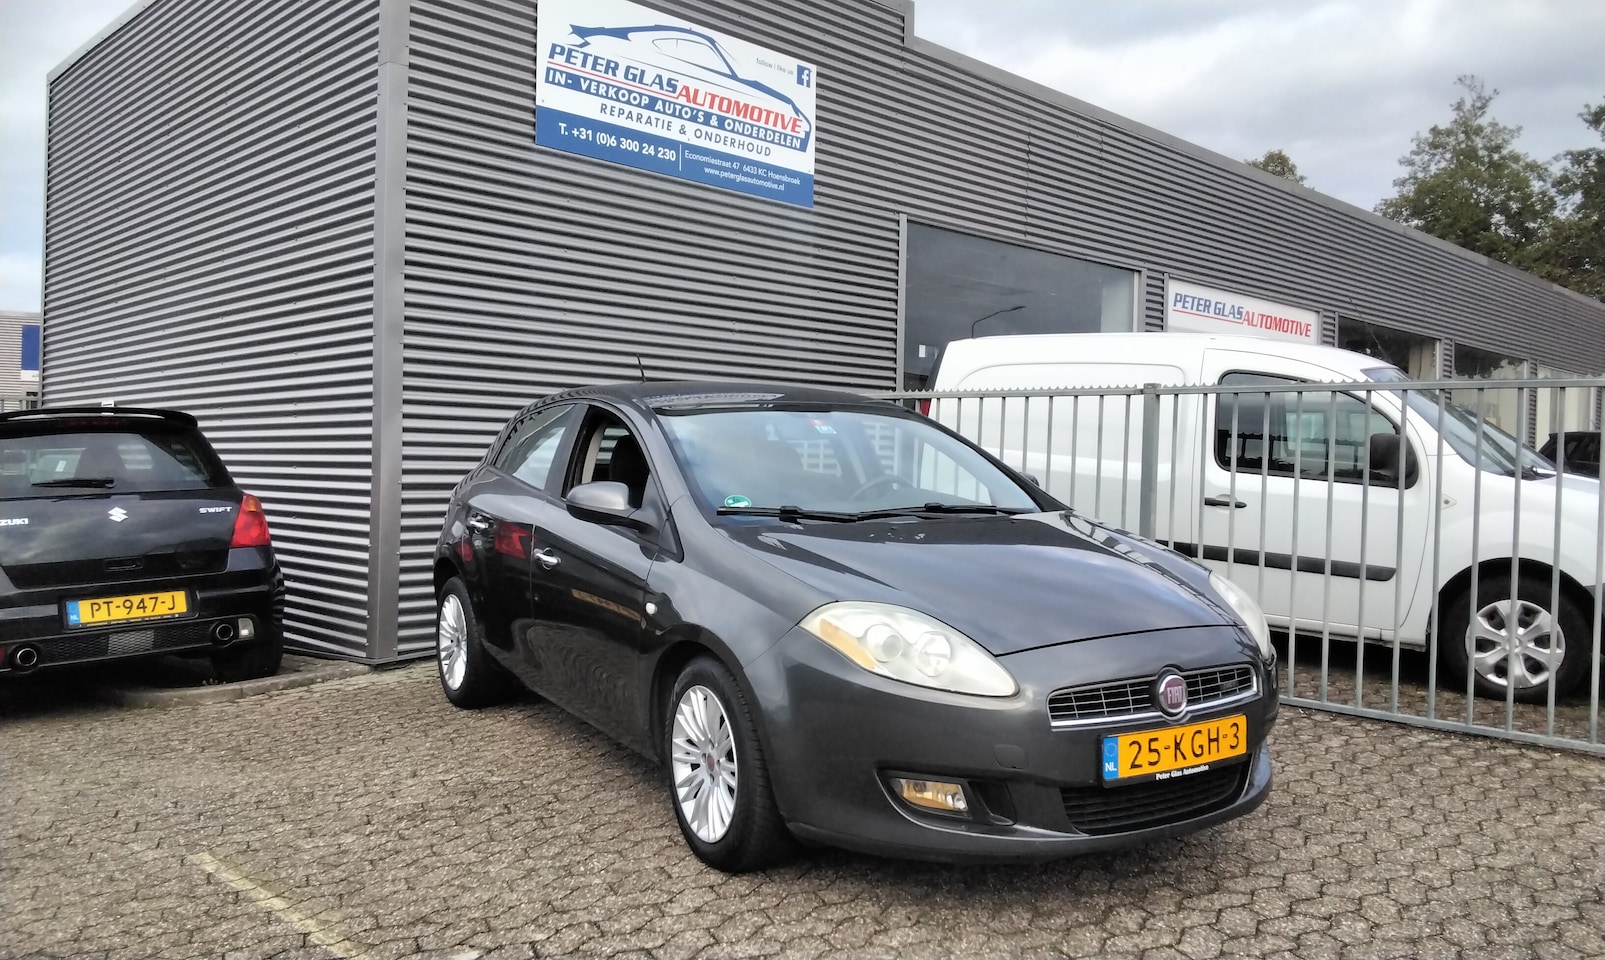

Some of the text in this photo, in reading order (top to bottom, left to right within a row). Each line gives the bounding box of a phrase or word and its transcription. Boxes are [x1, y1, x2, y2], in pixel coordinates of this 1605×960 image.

[548, 43, 620, 77] PETER
[676, 85, 803, 134] AUTOMOTIVE
[548, 69, 801, 149] IN- VERKOOP AUTO'S & ONDERDELEN
[558, 122, 677, 162] T. +31 (0)6 300 24 230
[600, 103, 771, 156] REPARATIE & ONDERHOUD
[684, 150, 801, 185] Economiestraat 47 6433 KC Hoensbroek
[704, 167, 785, 191] www.peterglasautomotive.nl
[1173, 292, 1212, 314] PETER
[1242, 310, 1312, 338] AUTOMOTIVE
[199, 506, 233, 514] SWIFT
[90, 595, 176, 619] PT-947-J
[1167, 685, 1183, 704] FIAT
[1129, 722, 1240, 770] 25-KGH-3
[1105, 762, 1117, 772] NL
[1156, 772, 1170, 781] Peter
[1170, 770, 1183, 778] Glas
